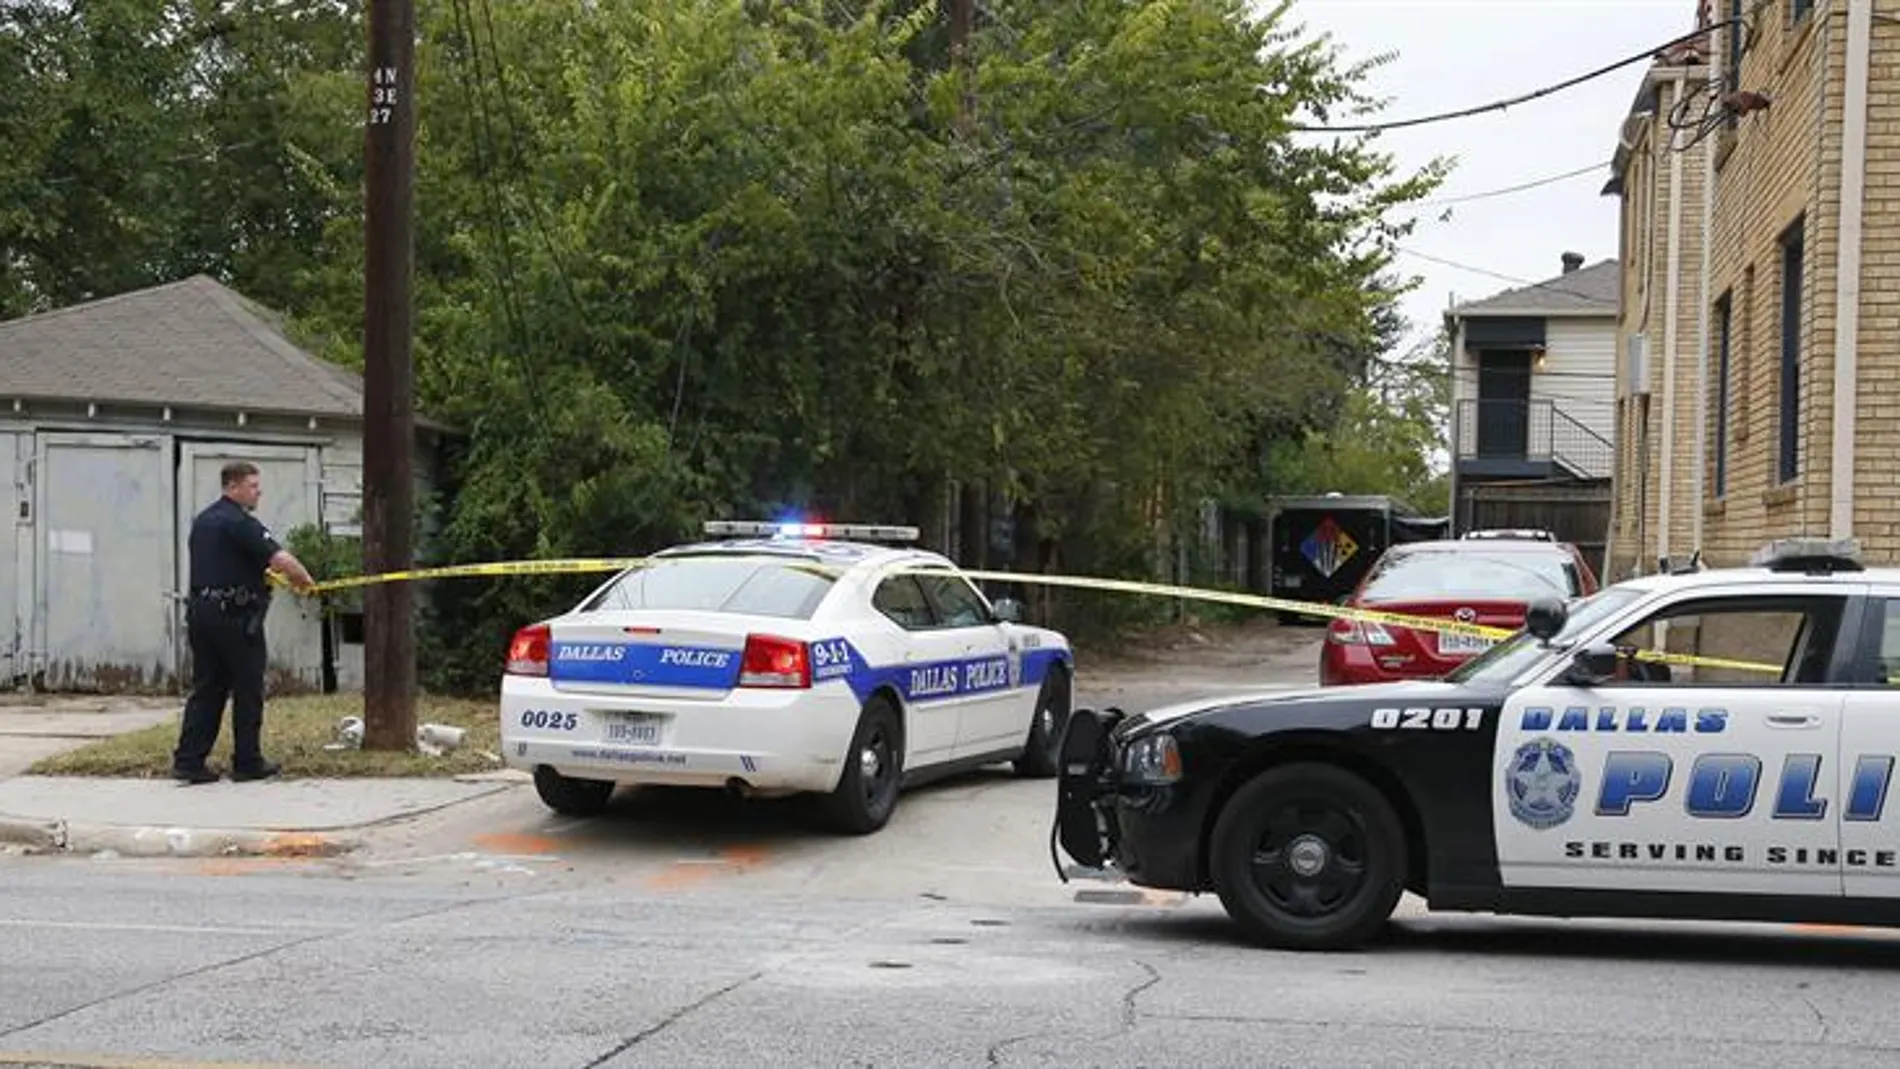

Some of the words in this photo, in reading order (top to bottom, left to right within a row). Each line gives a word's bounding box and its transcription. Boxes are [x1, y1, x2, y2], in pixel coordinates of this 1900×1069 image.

[557, 645, 626, 661] DALLAS
[659, 648, 731, 668] POLICE
[909, 665, 957, 696] DALLAS
[965, 659, 1007, 689] POLICE
[520, 709, 578, 731] 0025
[1370, 707, 1484, 729] 0201
[1520, 705, 1730, 733] DALLAS
[1594, 750, 1896, 822] POLI
[1564, 840, 1744, 863] SERVING
[1766, 846, 1896, 867] SINCE
